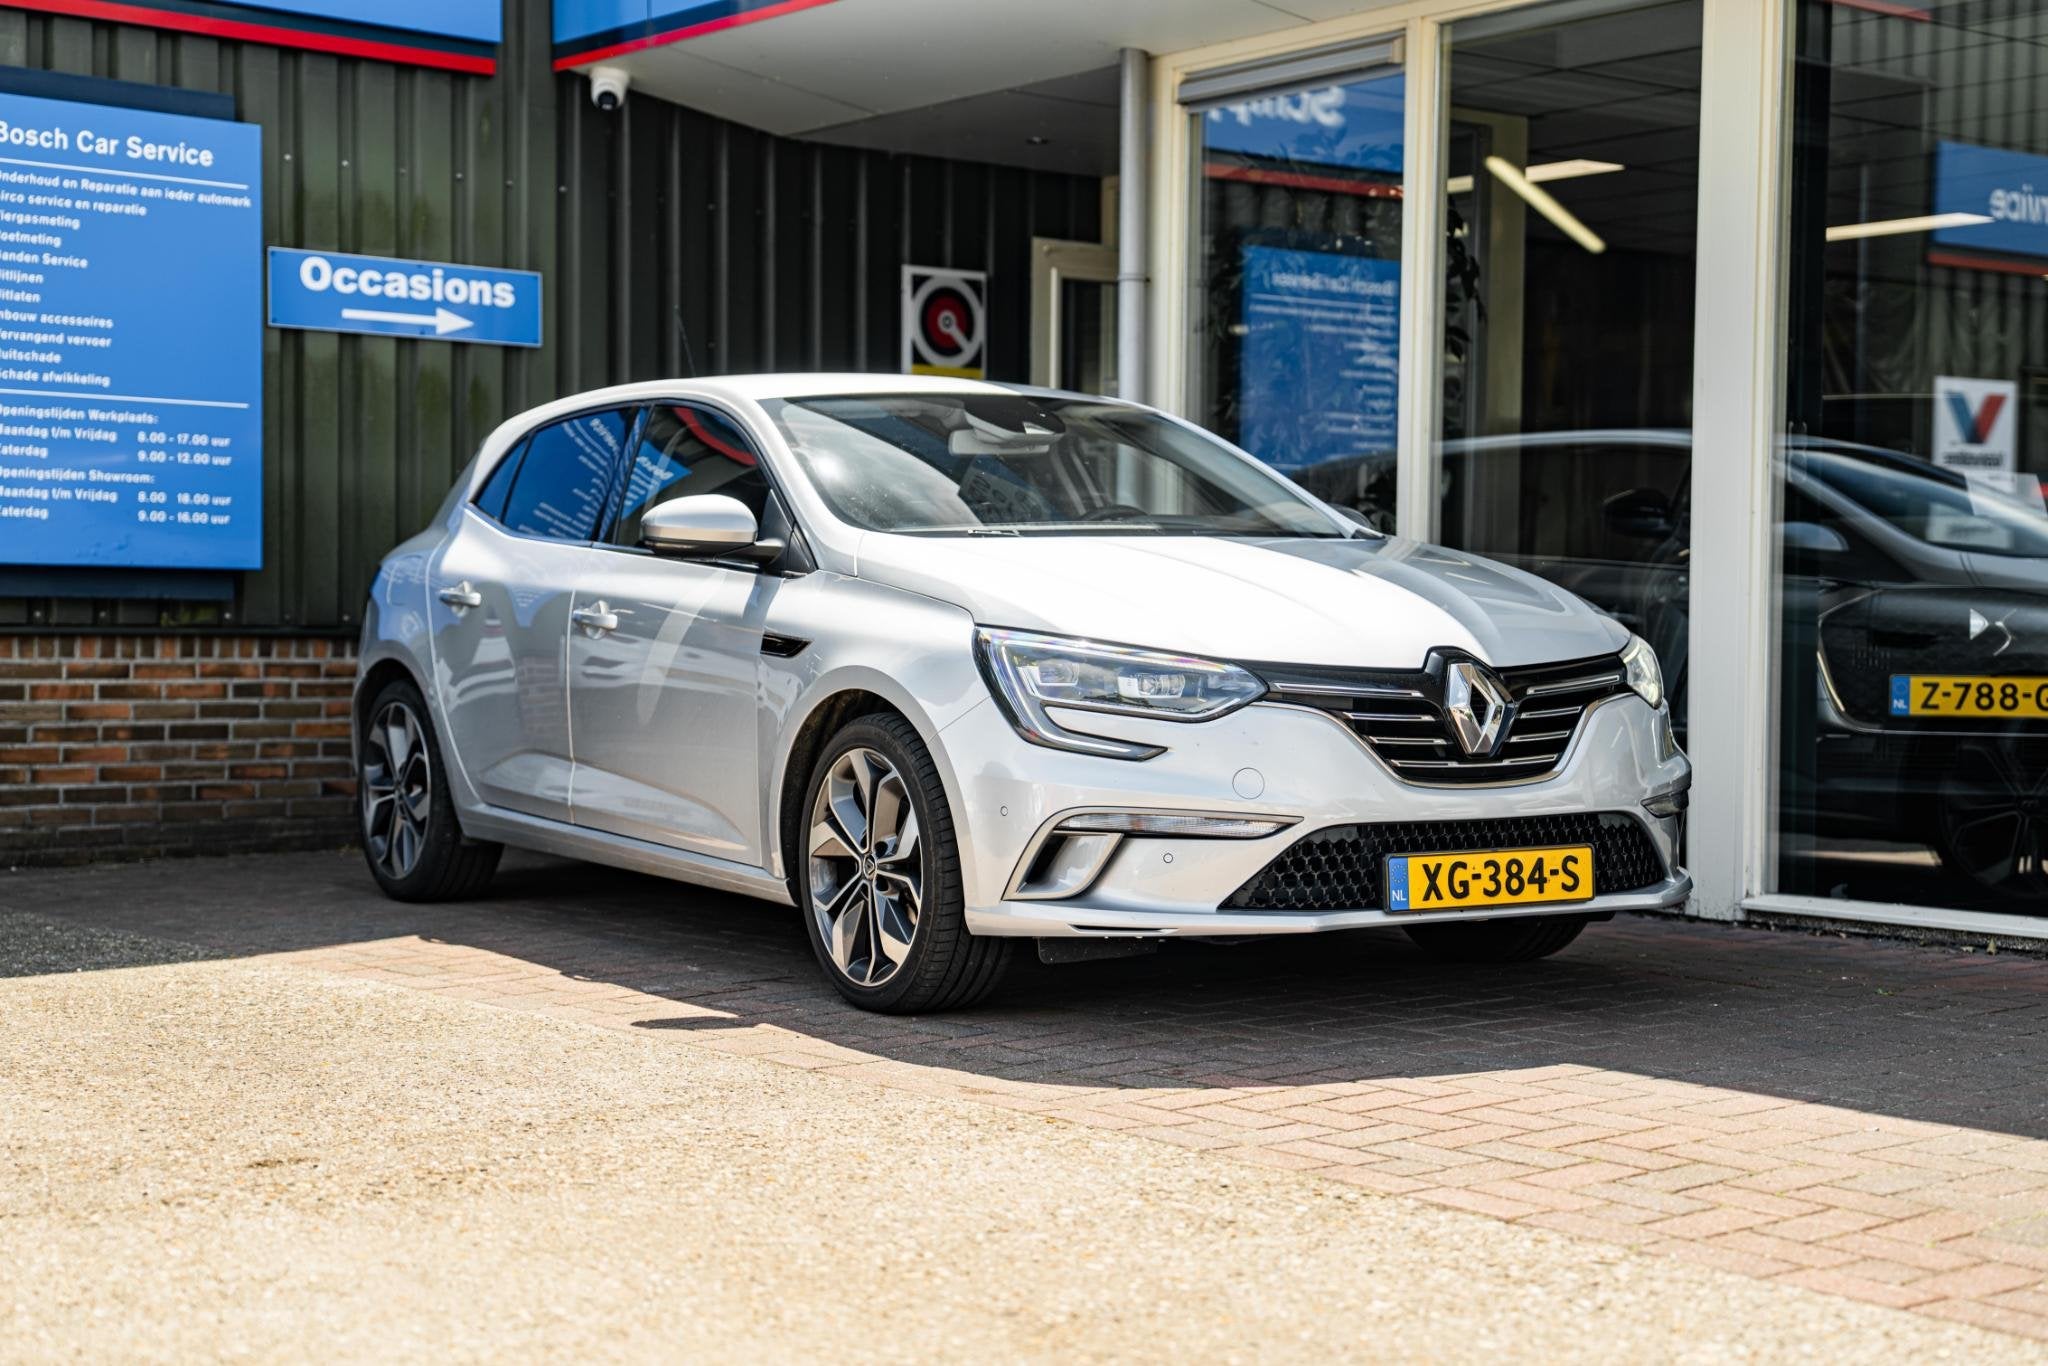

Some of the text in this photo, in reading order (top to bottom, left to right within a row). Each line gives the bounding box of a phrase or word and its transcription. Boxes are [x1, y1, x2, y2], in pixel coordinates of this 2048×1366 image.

[0, 120, 213, 167] Bosch Car Service
[0, 170, 60, 188] nderhoud
[62, 179, 78, 189] en
[80, 178, 138, 197] Reparatie
[0, 190, 147, 216] irco service en reparatie
[0, 209, 80, 231] iergasmeting
[0, 230, 62, 248] oetmeting
[0, 250, 88, 269] anden Service
[299, 256, 516, 308] Occasions
[40, 313, 114, 329] accessoires
[0, 328, 112, 348] ervangend vervoer
[0, 348, 62, 364] uitschade
[0, 367, 111, 388] chade afwikkeling
[0, 404, 85, 420] peningstijden
[51, 426, 72, 439] t/m
[74, 427, 118, 443] Vrijdag
[177, 433, 209, 447] 17.00
[211, 437, 231, 447] uur
[0, 443, 48, 459] aterdag
[137, 450, 167, 464] 9.00
[177, 452, 211, 465] 12.00
[212, 456, 232, 466] uur
[0, 466, 156, 484] peningstijden Showroom:
[51, 487, 72, 500] t/m
[74, 488, 119, 504] Vrijdag
[212, 496, 232, 506] uur
[0, 505, 49, 520] aterdag
[211, 515, 231, 525] uur
[1893, 699, 1908, 709] NL
[1920, 682, 2048, 712] Z-788-G
[1422, 855, 1581, 902] XG-384-S
[1392, 889, 1407, 902] NL
